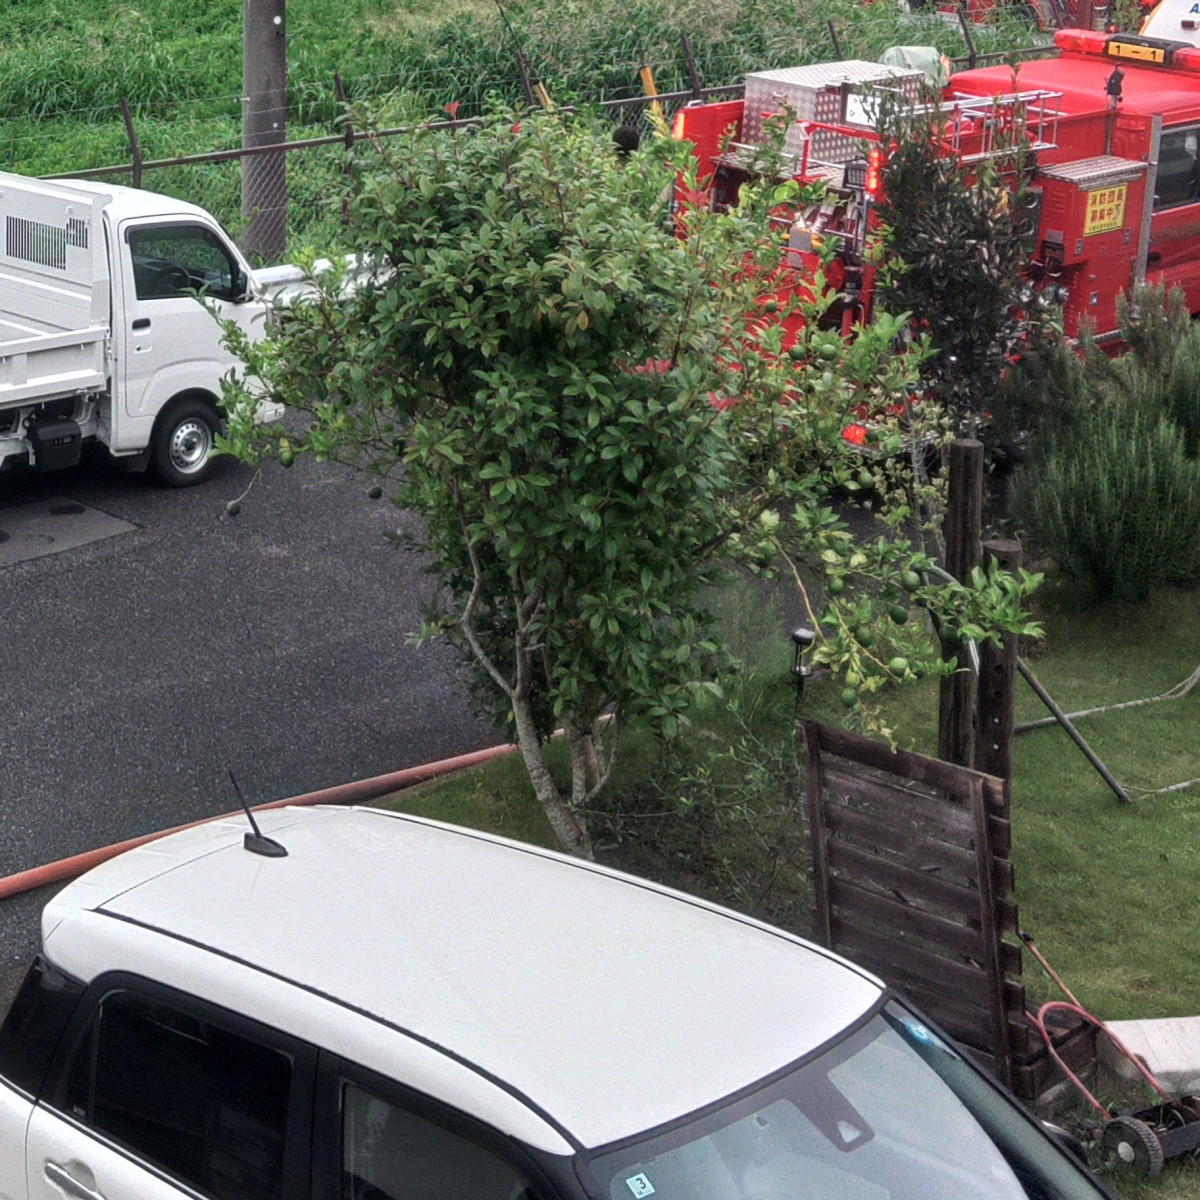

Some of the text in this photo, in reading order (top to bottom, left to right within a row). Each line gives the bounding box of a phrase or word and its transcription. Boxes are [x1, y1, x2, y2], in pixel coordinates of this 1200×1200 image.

[1090, 188, 1124, 208] 消防団員
[636, 1177, 646, 1189] 3
